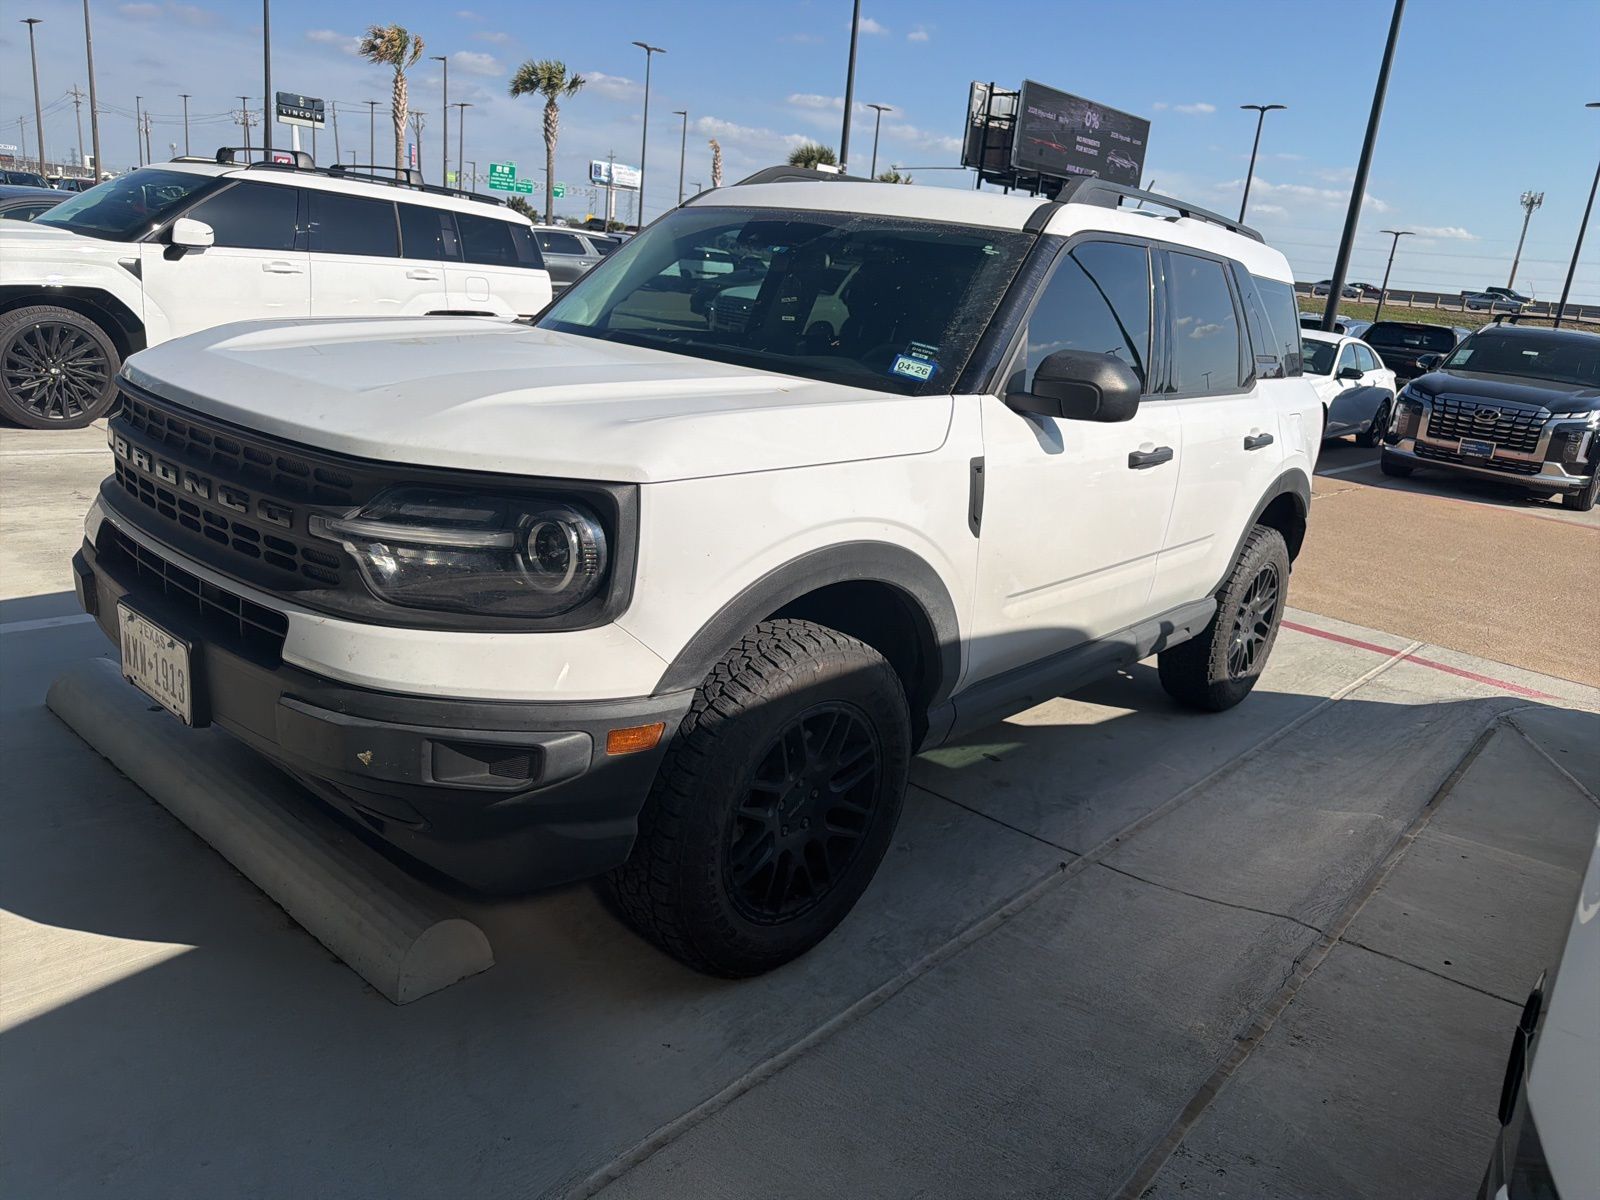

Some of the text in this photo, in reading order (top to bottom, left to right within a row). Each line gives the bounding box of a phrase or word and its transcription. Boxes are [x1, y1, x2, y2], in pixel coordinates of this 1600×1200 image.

[282, 109, 322, 120] LINCON
[1085, 111, 1099, 129] 0%
[897, 361, 928, 375] 04 26
[115, 434, 293, 529] BRONCO
[139, 620, 166, 650] TEXAS
[153, 651, 186, 705] 1913
